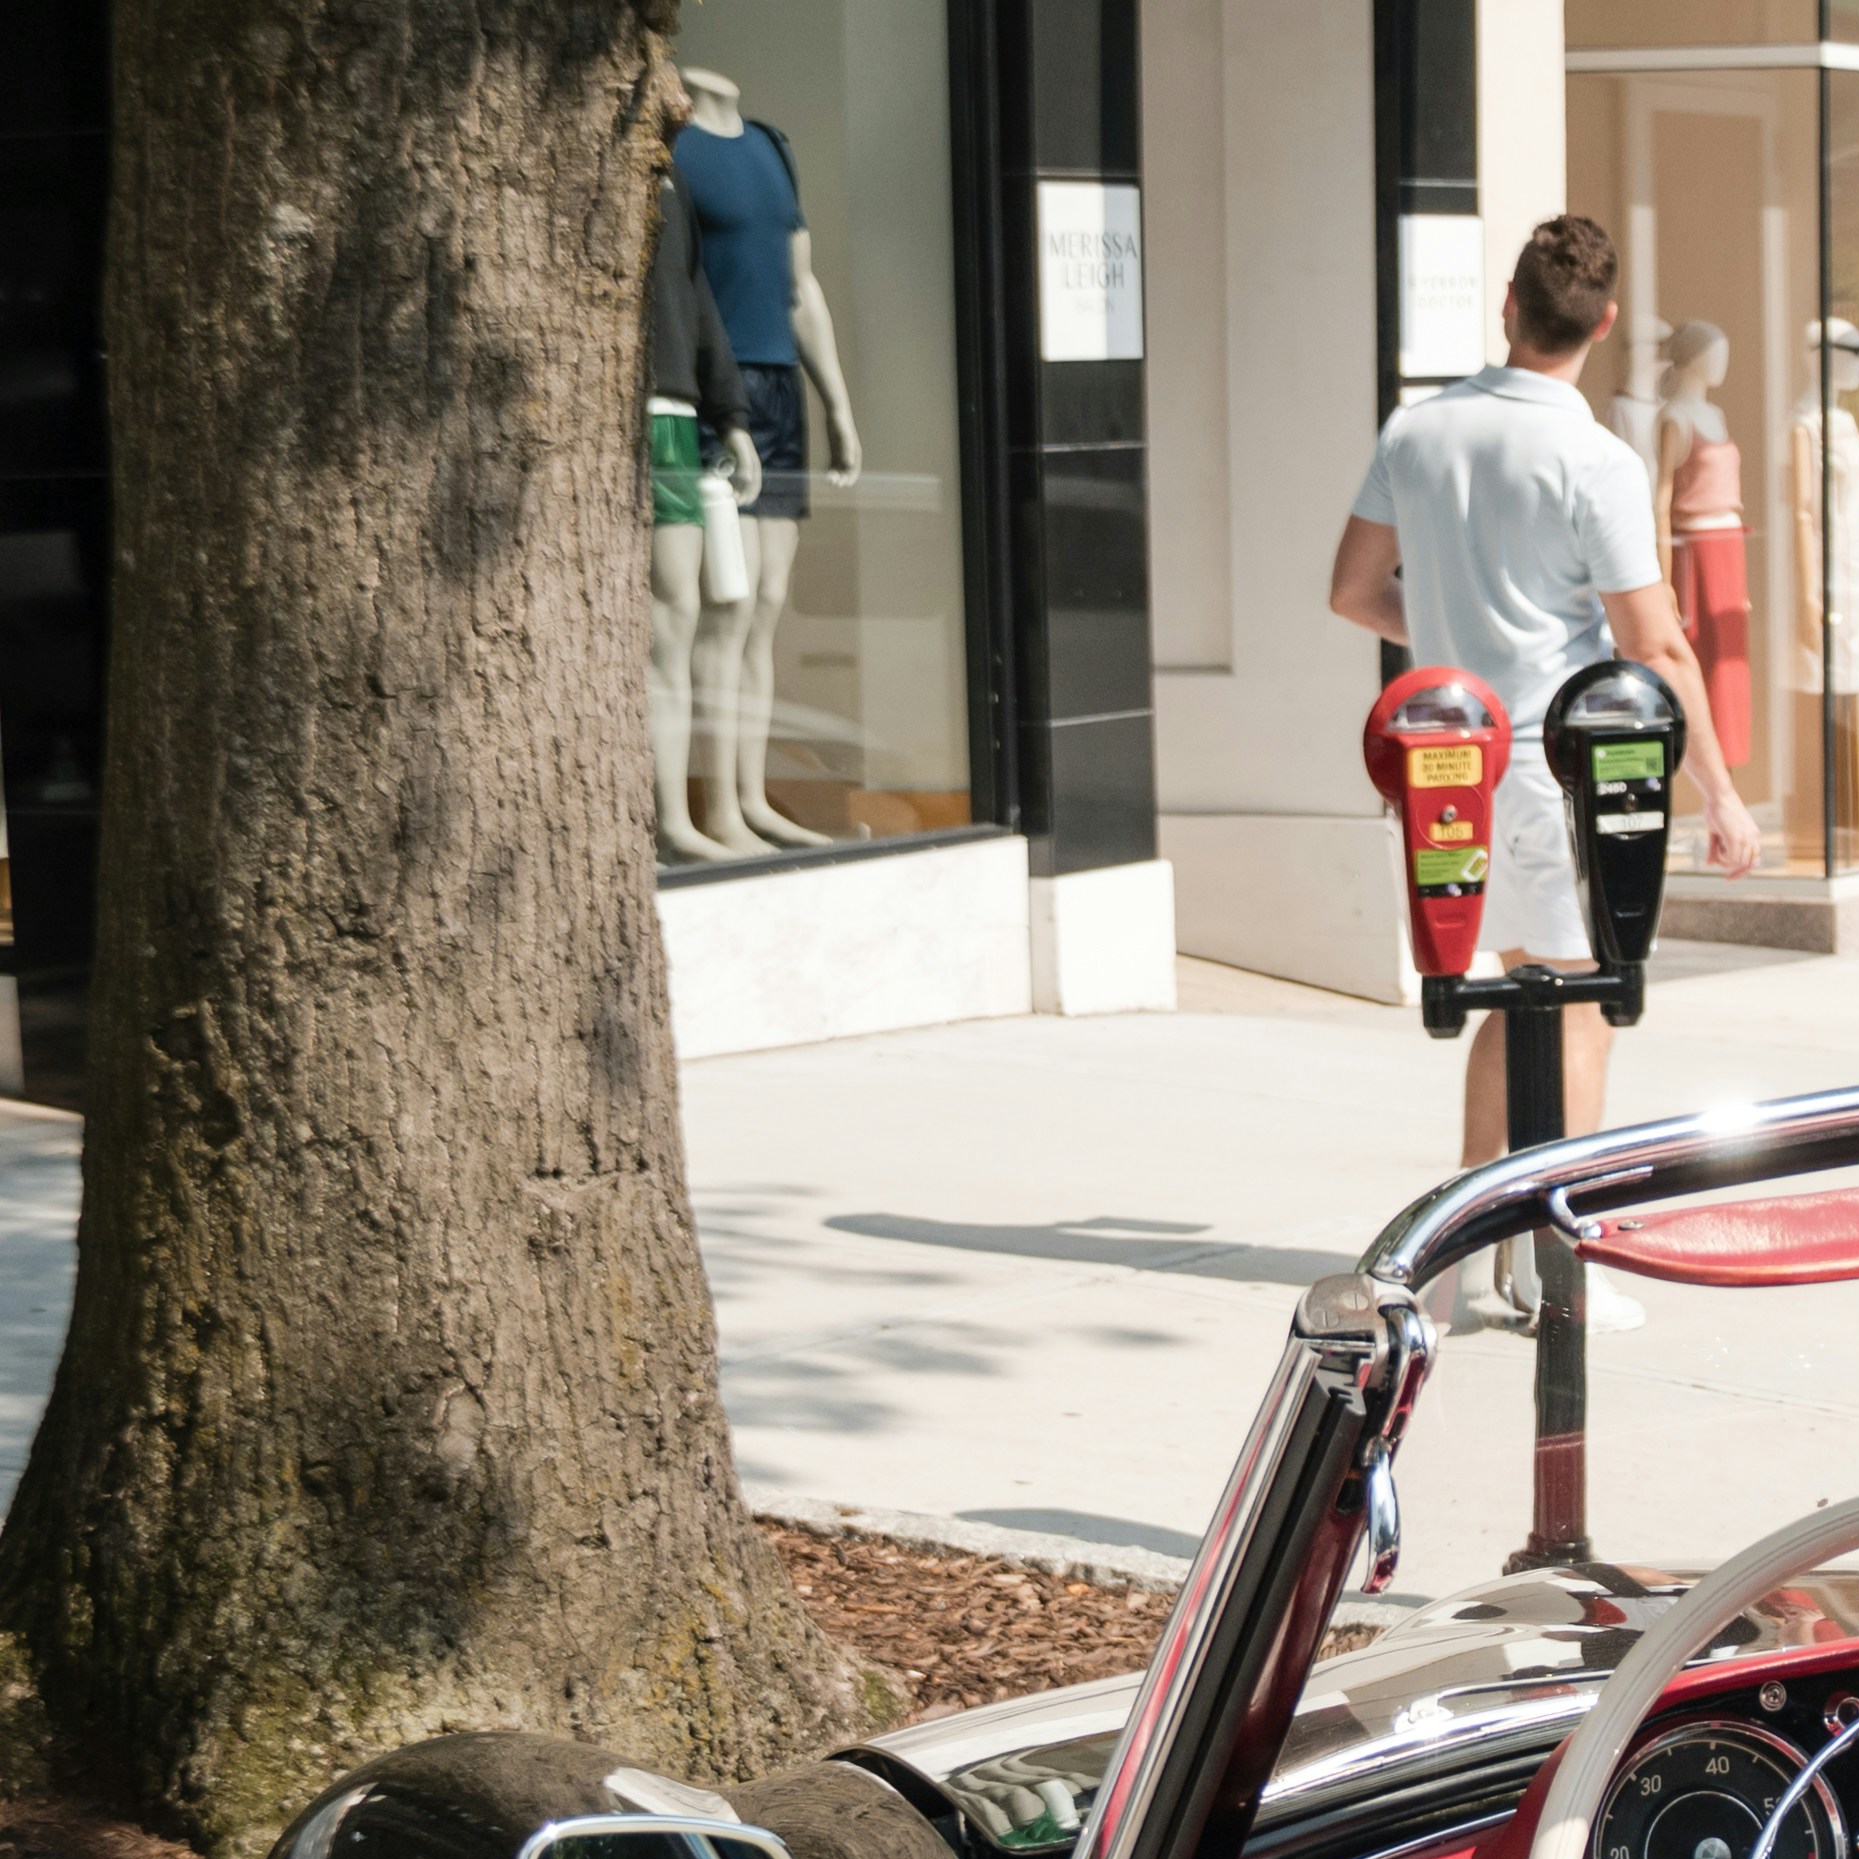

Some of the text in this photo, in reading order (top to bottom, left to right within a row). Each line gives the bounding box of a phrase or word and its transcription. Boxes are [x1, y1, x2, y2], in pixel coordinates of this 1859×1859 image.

[1050, 232, 1138, 260] MERISSA
[1065, 262, 1125, 289] LEIGH
[1423, 750, 1472, 760] MAXIMUM
[1436, 762, 1471, 771] MINUTE
[1427, 772, 1468, 782] PARKING
[1705, 1756, 1730, 1775] 40
[1640, 1775, 1662, 1796] 30
